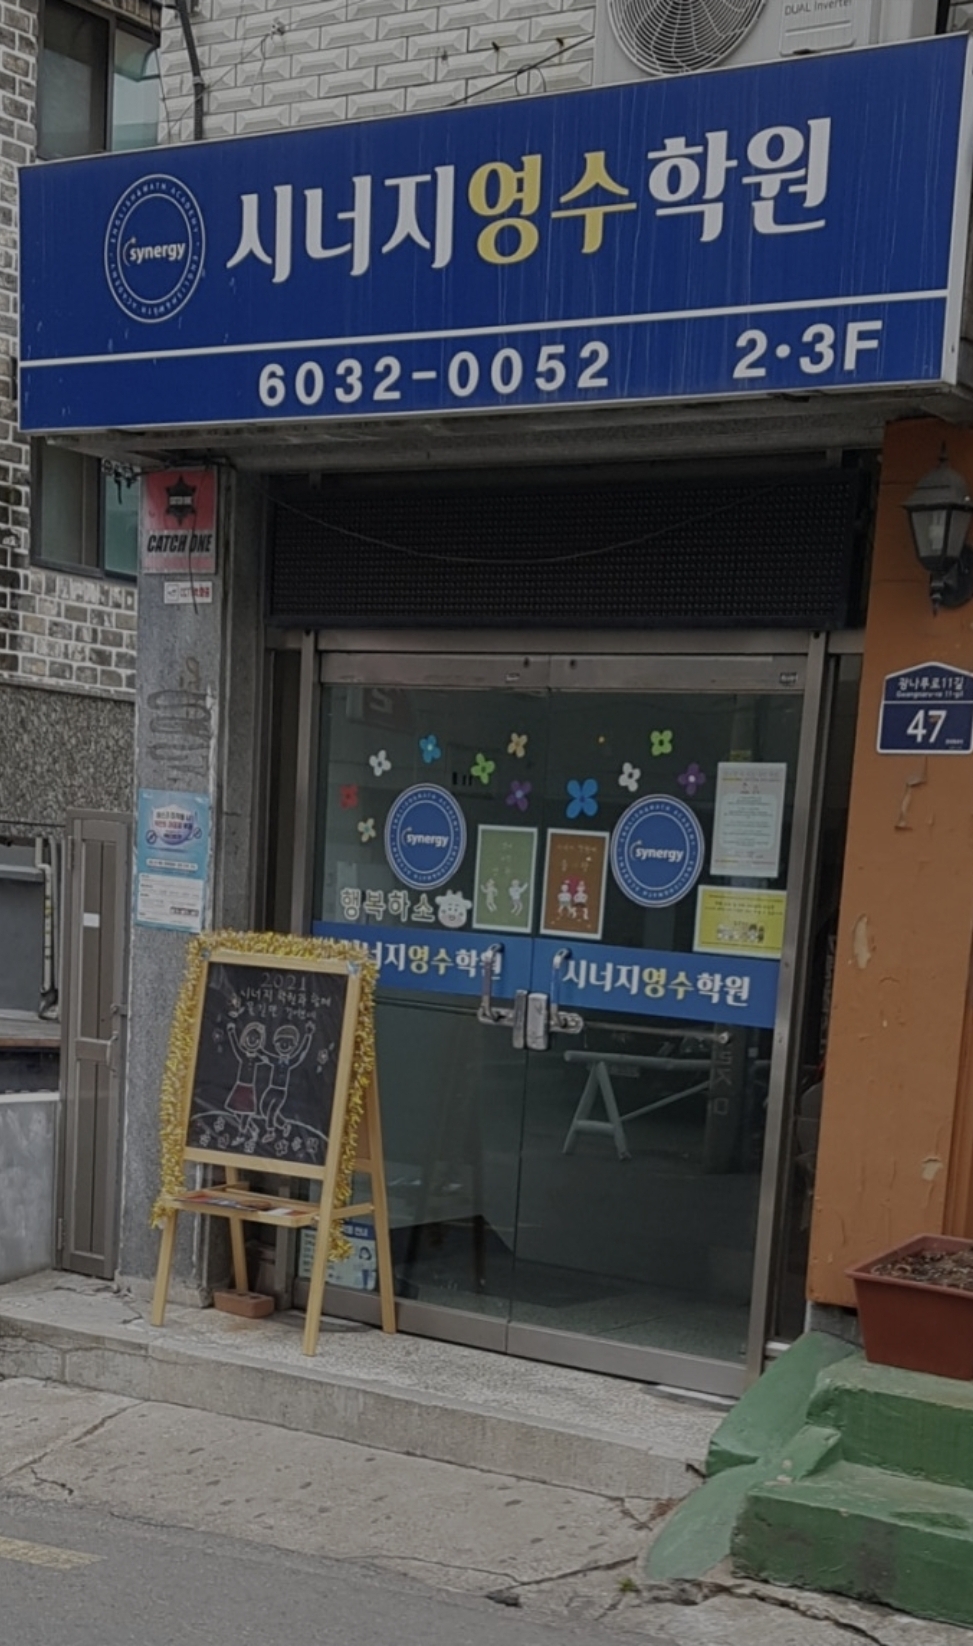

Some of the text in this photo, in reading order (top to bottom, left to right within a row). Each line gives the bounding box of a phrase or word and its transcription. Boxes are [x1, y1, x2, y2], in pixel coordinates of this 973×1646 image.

[785, 3, 811, 16] DUAL
[226, 117, 831, 283] 시너지영수학원
[129, 241, 186, 265] synergy
[258, 340, 610, 409] 6032-0052
[147, 534, 213, 553] CATCH ONE
[906, 709, 947, 742] 47
[406, 833, 449, 849] synergy
[635, 846, 684, 862] synergy
[340, 887, 435, 922] 행복하소
[260, 971, 306, 991] 2021
[562, 958, 751, 1007] 시너지영수학원
